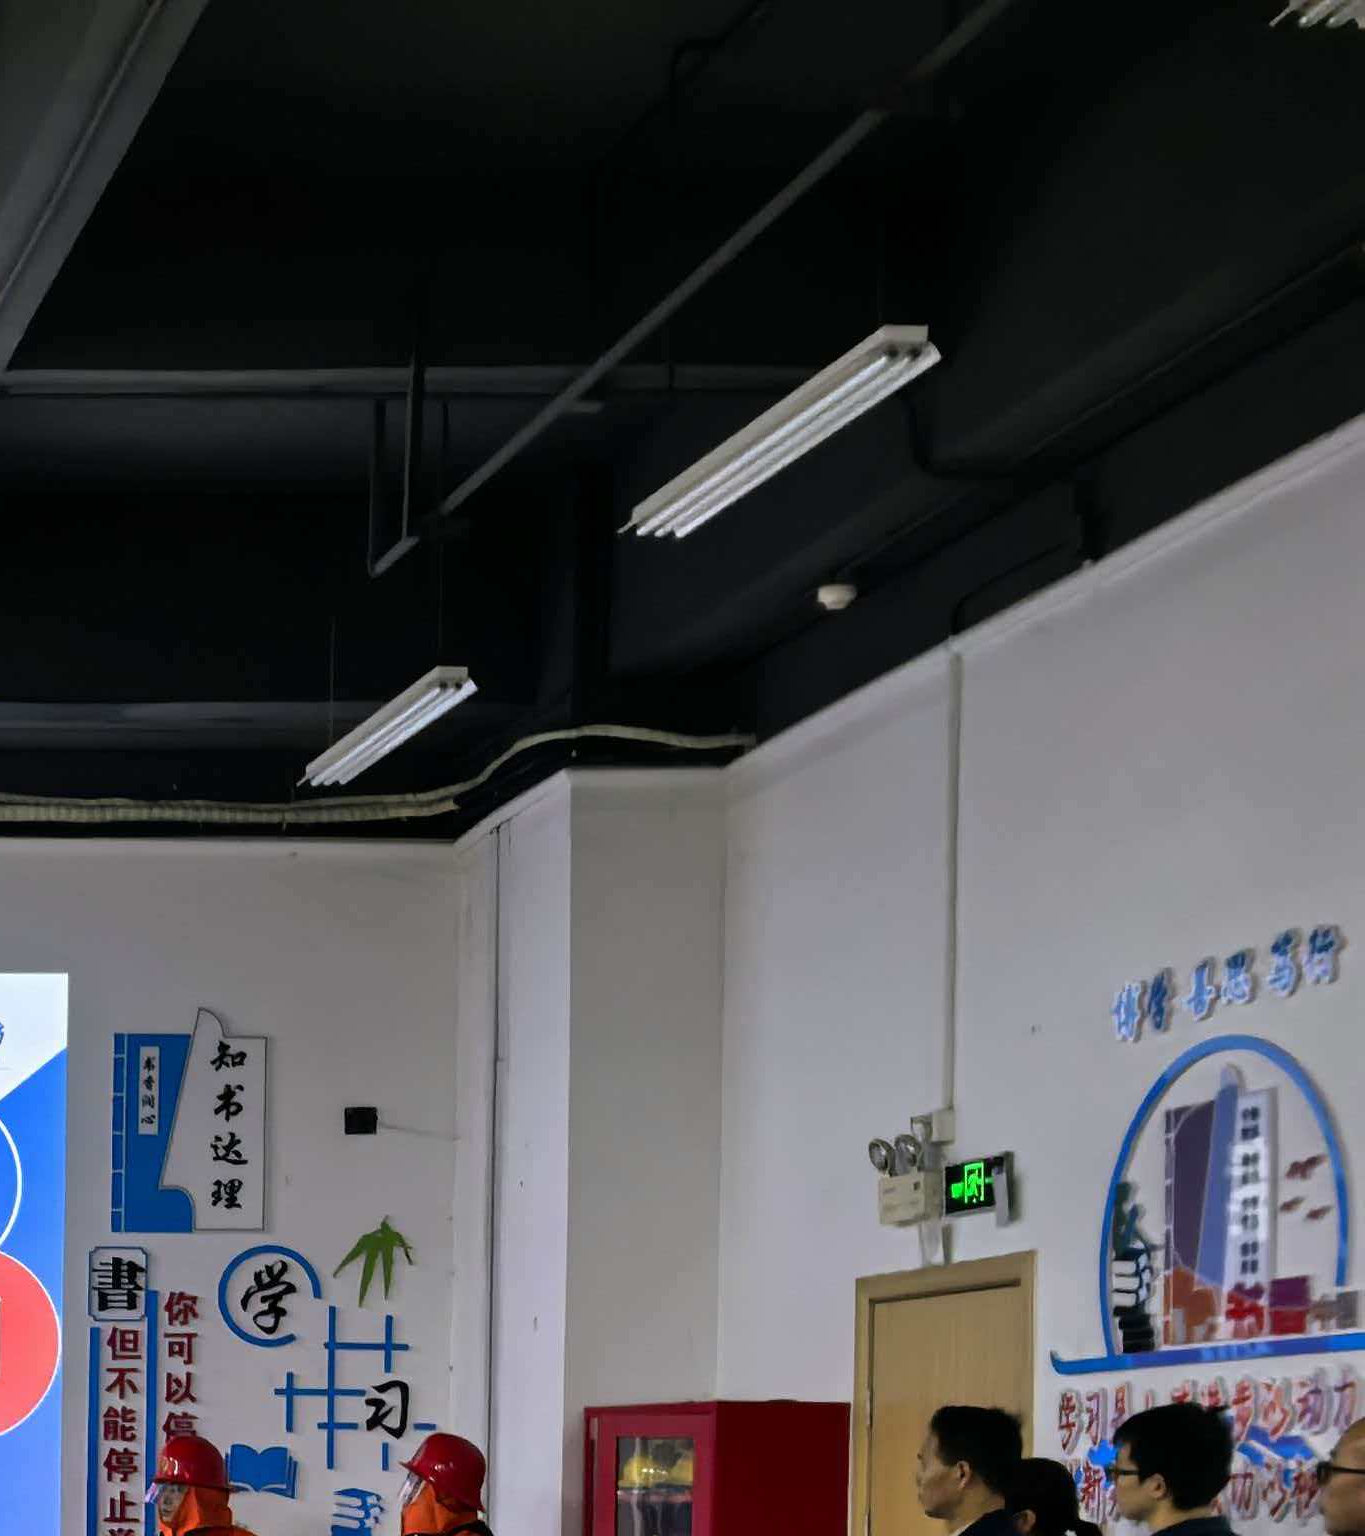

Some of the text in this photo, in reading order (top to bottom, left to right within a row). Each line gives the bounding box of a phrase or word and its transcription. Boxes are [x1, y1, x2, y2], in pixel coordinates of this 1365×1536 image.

[210, 1041, 248, 1210] 知书达理
[241, 1260, 410, 1439] 学 习
